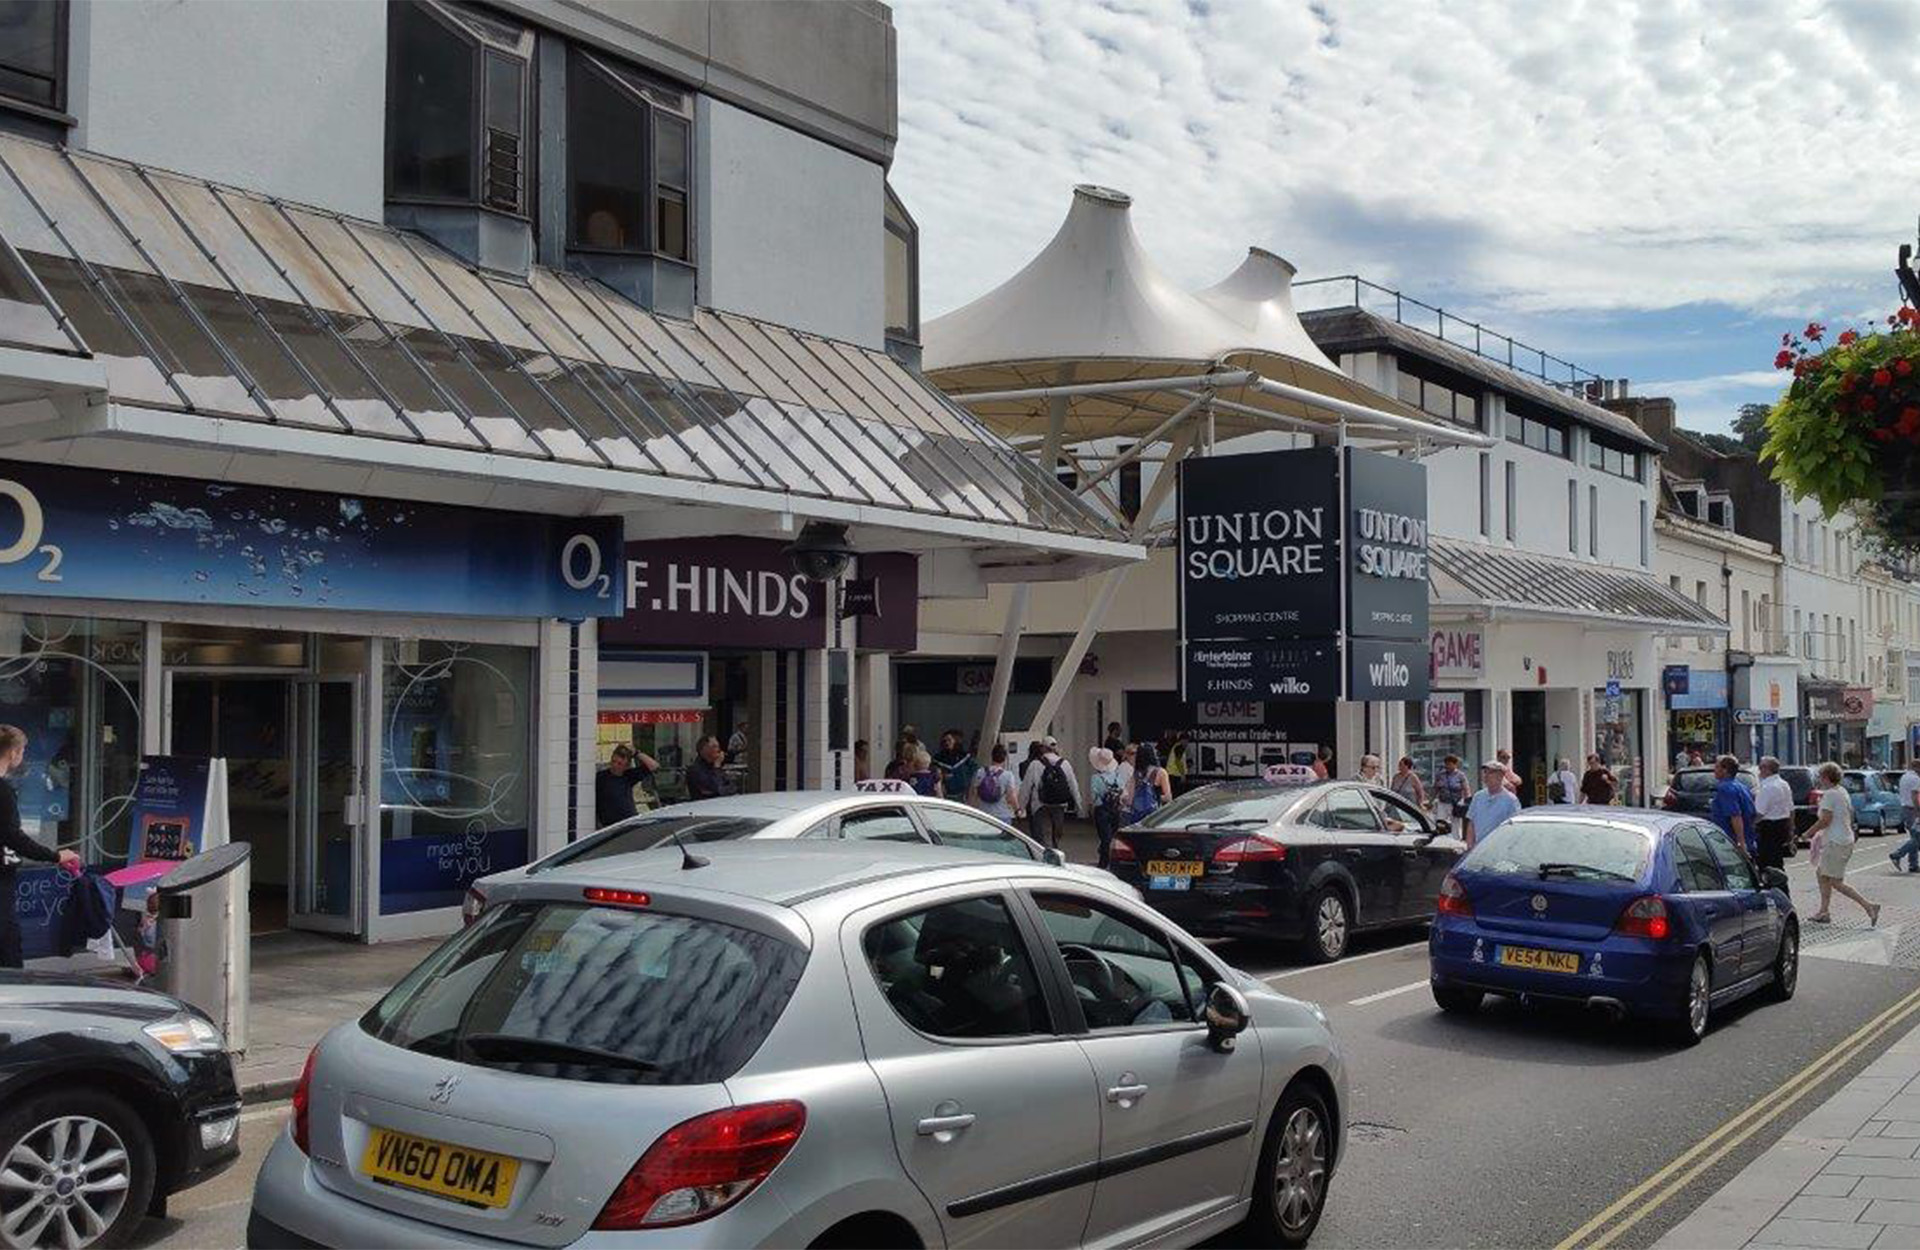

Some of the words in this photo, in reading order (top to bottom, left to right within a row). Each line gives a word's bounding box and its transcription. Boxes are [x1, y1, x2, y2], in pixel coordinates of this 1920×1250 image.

[1188, 507, 1323, 544] UNION
[1360, 508, 1426, 548] UNION
[561, 534, 610, 598] O2
[1189, 545, 1323, 580] SQUARE
[1361, 545, 1426, 580] SQUARE
[1264, 611, 1299, 622] CENTRE
[1432, 631, 1480, 669] GAME
[1369, 652, 1409, 687] wilko
[1270, 676, 1310, 694] wilko
[620, 712, 648, 723] SALE
[1205, 701, 1257, 717] GAME
[1427, 701, 1464, 728] GAME
[1270, 767, 1306, 775] TAXI
[856, 783, 901, 792] TAXI
[427, 844, 463, 859] more
[455, 855, 491, 881] you
[15, 878, 51, 895] ore
[1507, 948, 1542, 965] VE54
[1546, 952, 1574, 969] NKL
[375, 1132, 441, 1182] VN60
[443, 1151, 500, 1197] OMA
